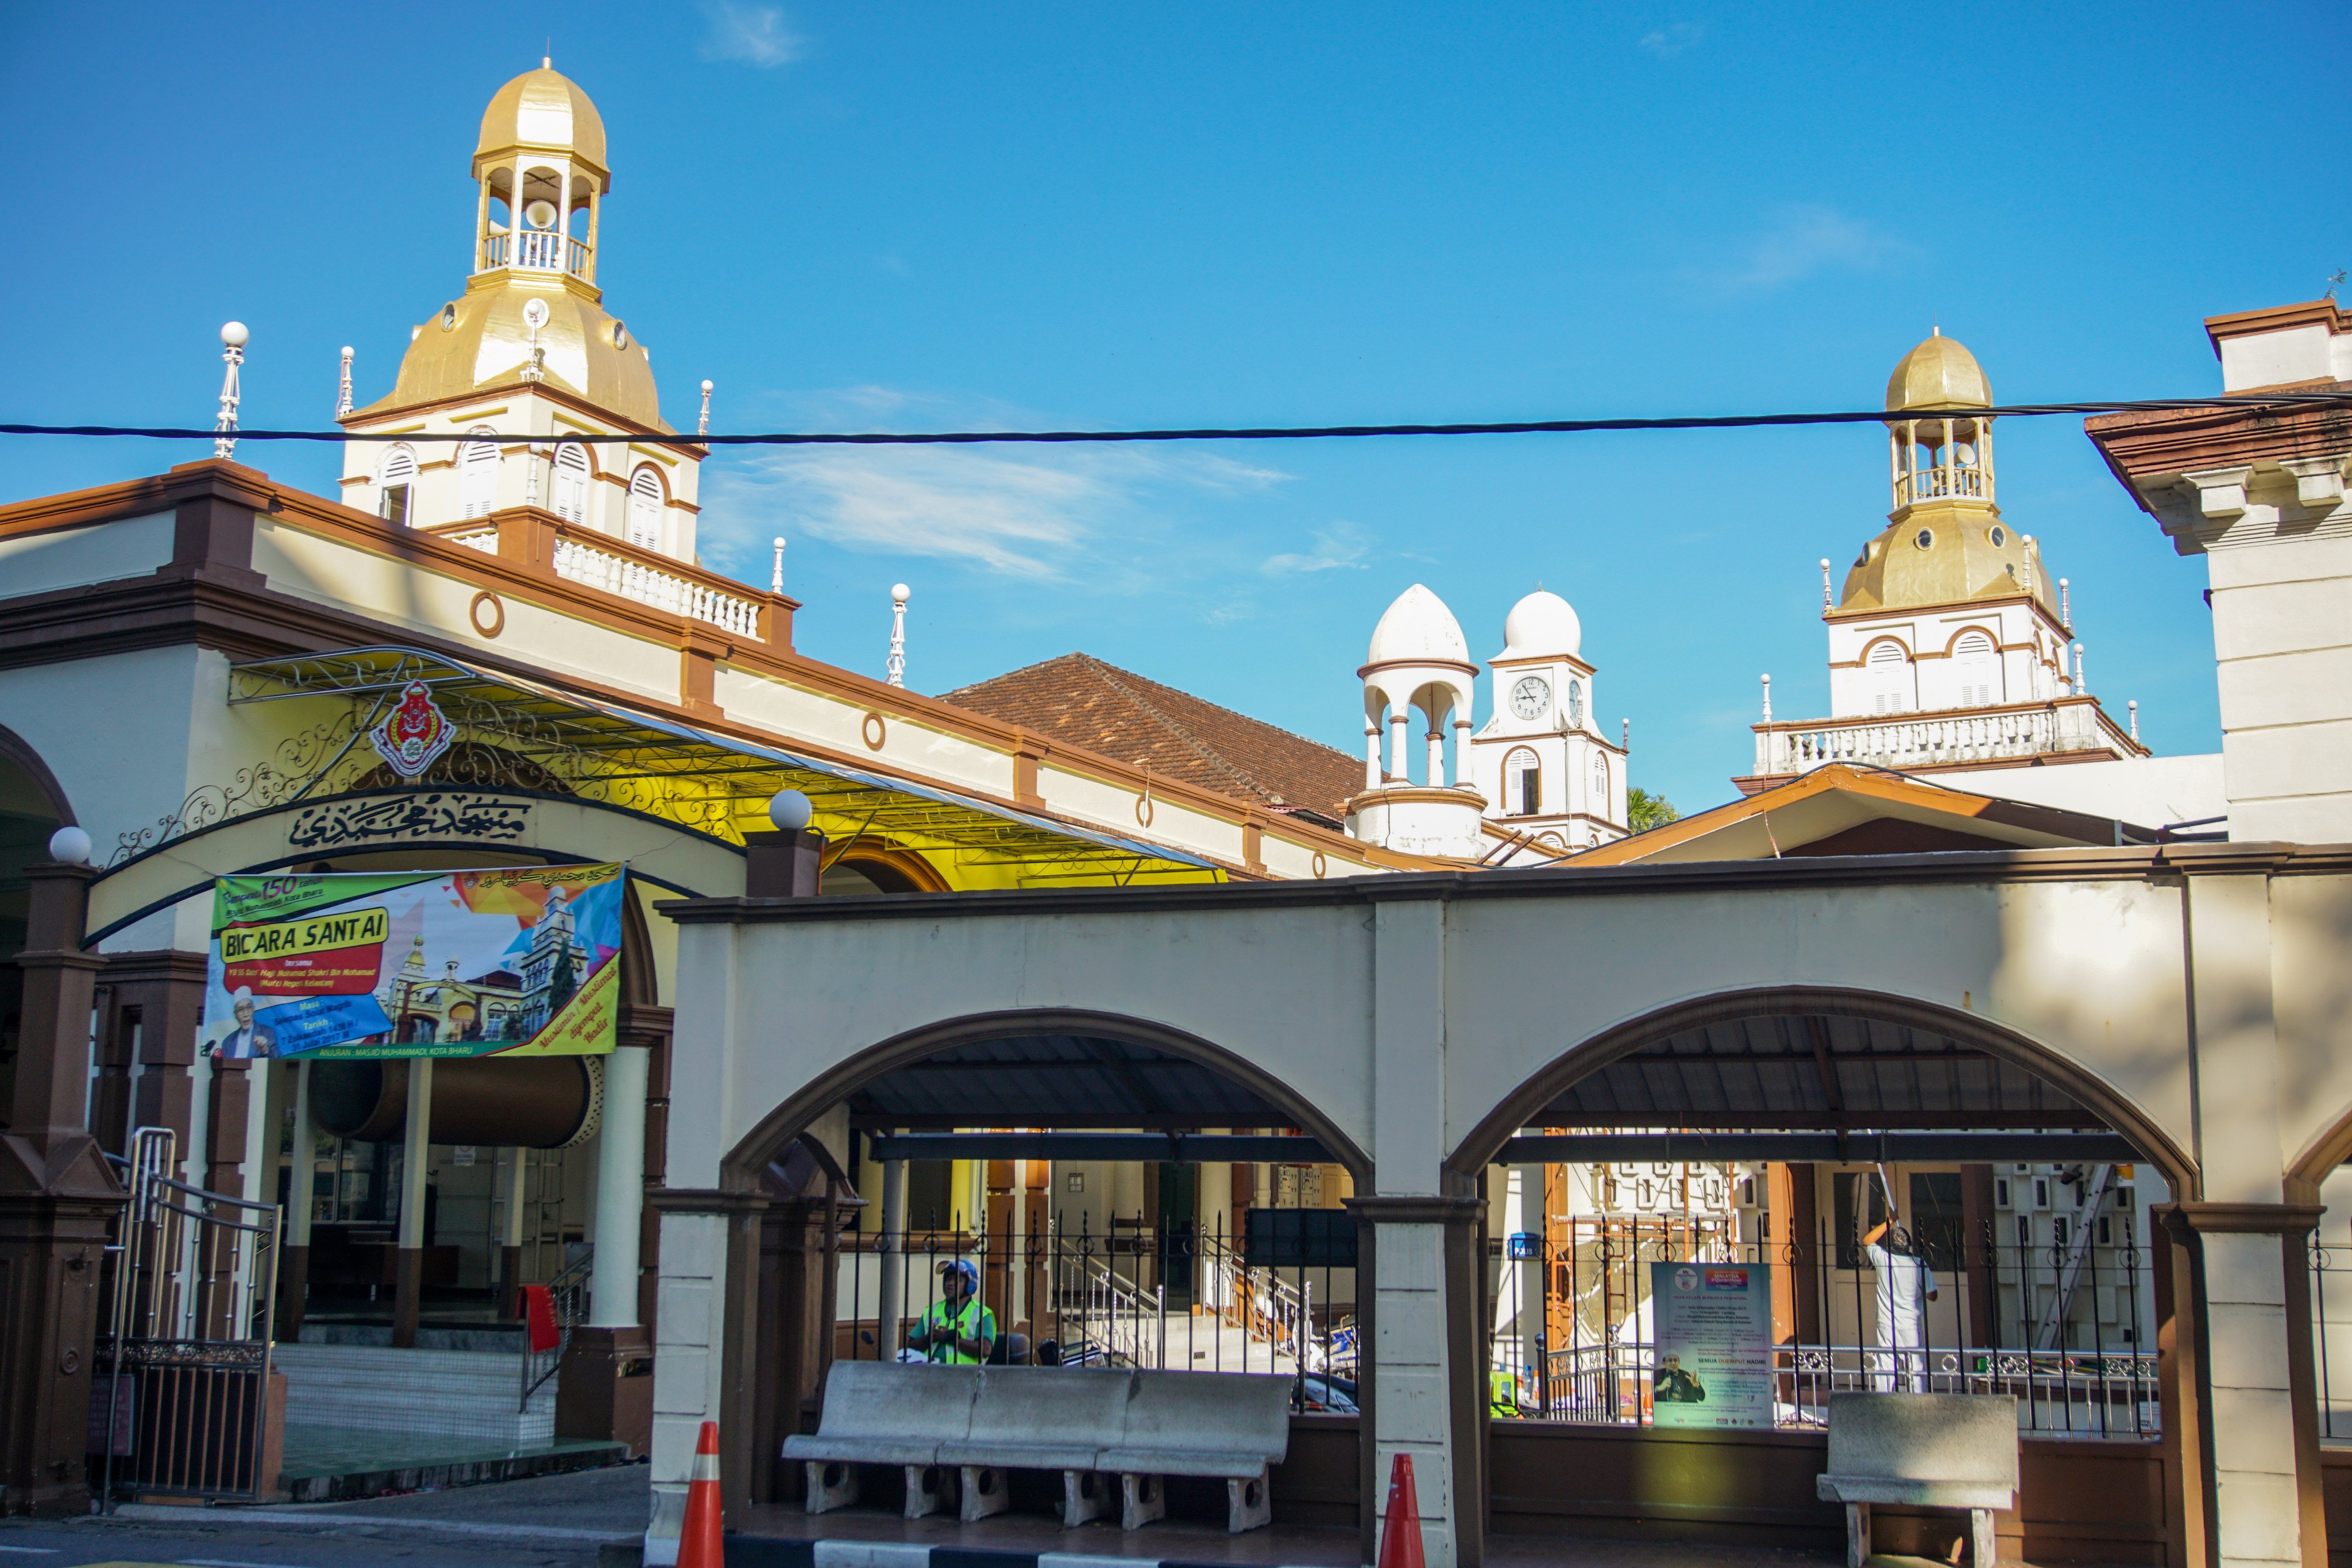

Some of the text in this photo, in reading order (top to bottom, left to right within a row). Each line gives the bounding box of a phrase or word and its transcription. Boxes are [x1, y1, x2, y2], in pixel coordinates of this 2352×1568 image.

[261, 875, 298, 901] 150
[299, 876, 323, 888] tahun
[284, 894, 301, 903] Kota
[302, 889, 323, 898] Bharu
[226, 914, 384, 957] BICARA SANTAI
[260, 969, 275, 978] Haji
[283, 980, 303, 988] Negeri
[299, 1001, 320, 1011] Masa
[539, 1011, 576, 1050] Muslimin
[578, 967, 616, 1006] Muslimat
[303, 1018, 329, 1030] Tarikh
[347, 1019, 354, 1028] H
[322, 1033, 341, 1044] 2017
[319, 1048, 351, 1057] ANJURAN
[355, 1048, 380, 1056] MASJID
[448, 1046, 473, 1055] BHARU
